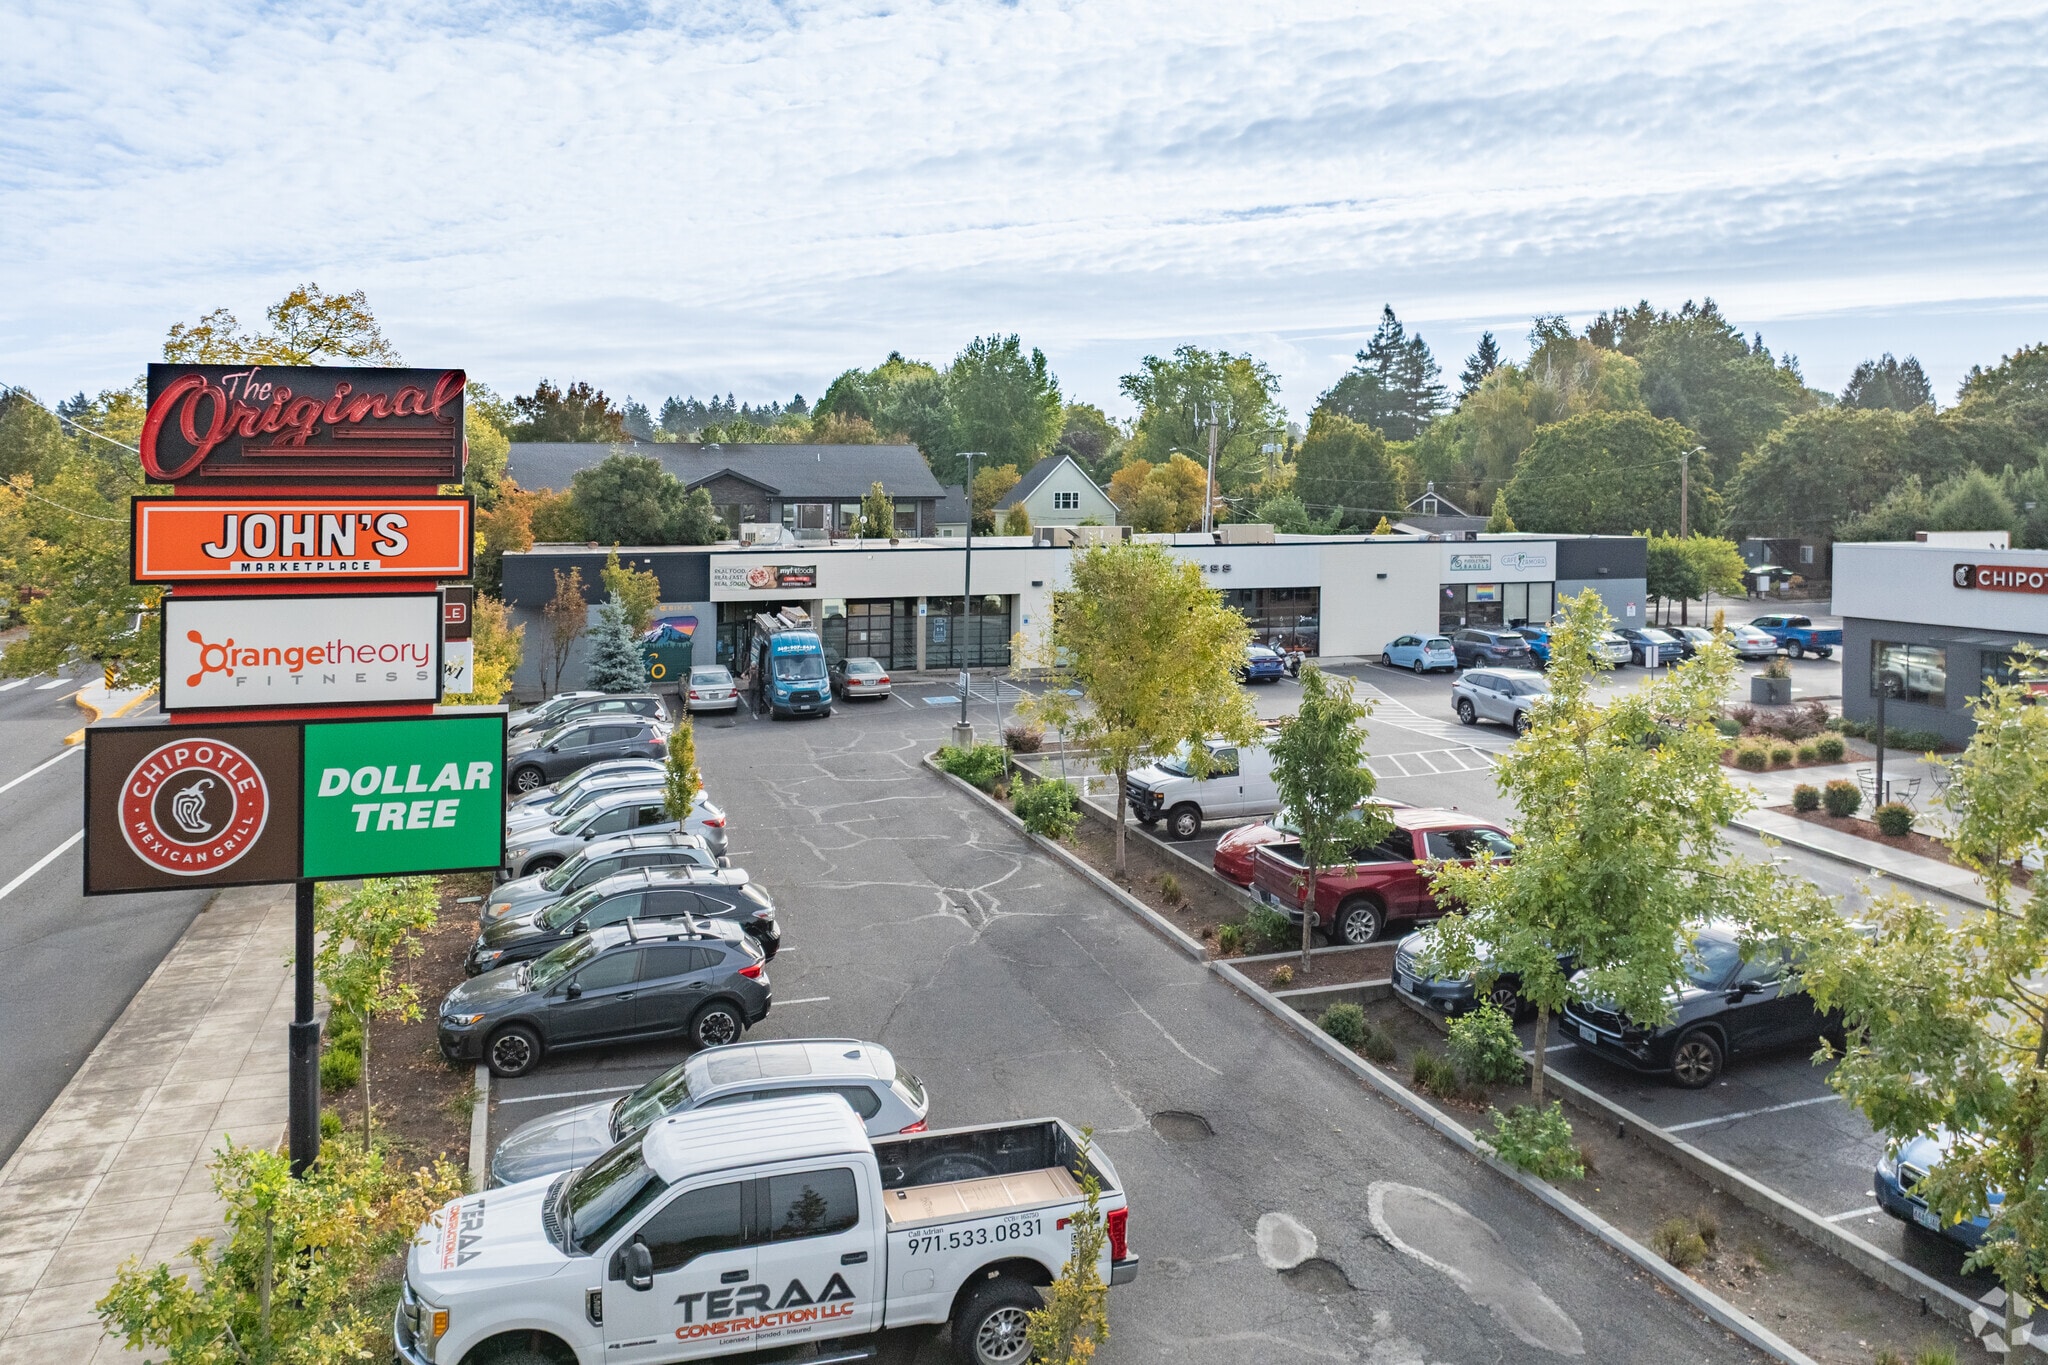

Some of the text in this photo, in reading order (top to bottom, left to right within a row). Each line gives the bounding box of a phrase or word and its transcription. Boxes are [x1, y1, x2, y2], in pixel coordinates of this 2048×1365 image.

[222, 367, 272, 400] The
[140, 369, 466, 480] Original
[201, 513, 409, 558] JOHN'S
[241, 562, 371, 572] MARKETPLACE
[236, 671, 429, 687] FITNESS
[132, 747, 256, 797] CHIPOTLE
[318, 761, 493, 797] DOLLAR
[351, 799, 460, 832] TREE
[135, 817, 253, 863] MEXICAN GRILL
[457, 1199, 485, 1267] TERAA
[908, 1219, 1041, 1256] 971.533.0831
[922, 1227, 944, 1237] Adrian
[673, 1272, 856, 1324] TERAA
[675, 1302, 854, 1340] CONSTRUCTION LLC
[719, 1336, 750, 1345] Licensed
[786, 1326, 811, 1336] Insured
